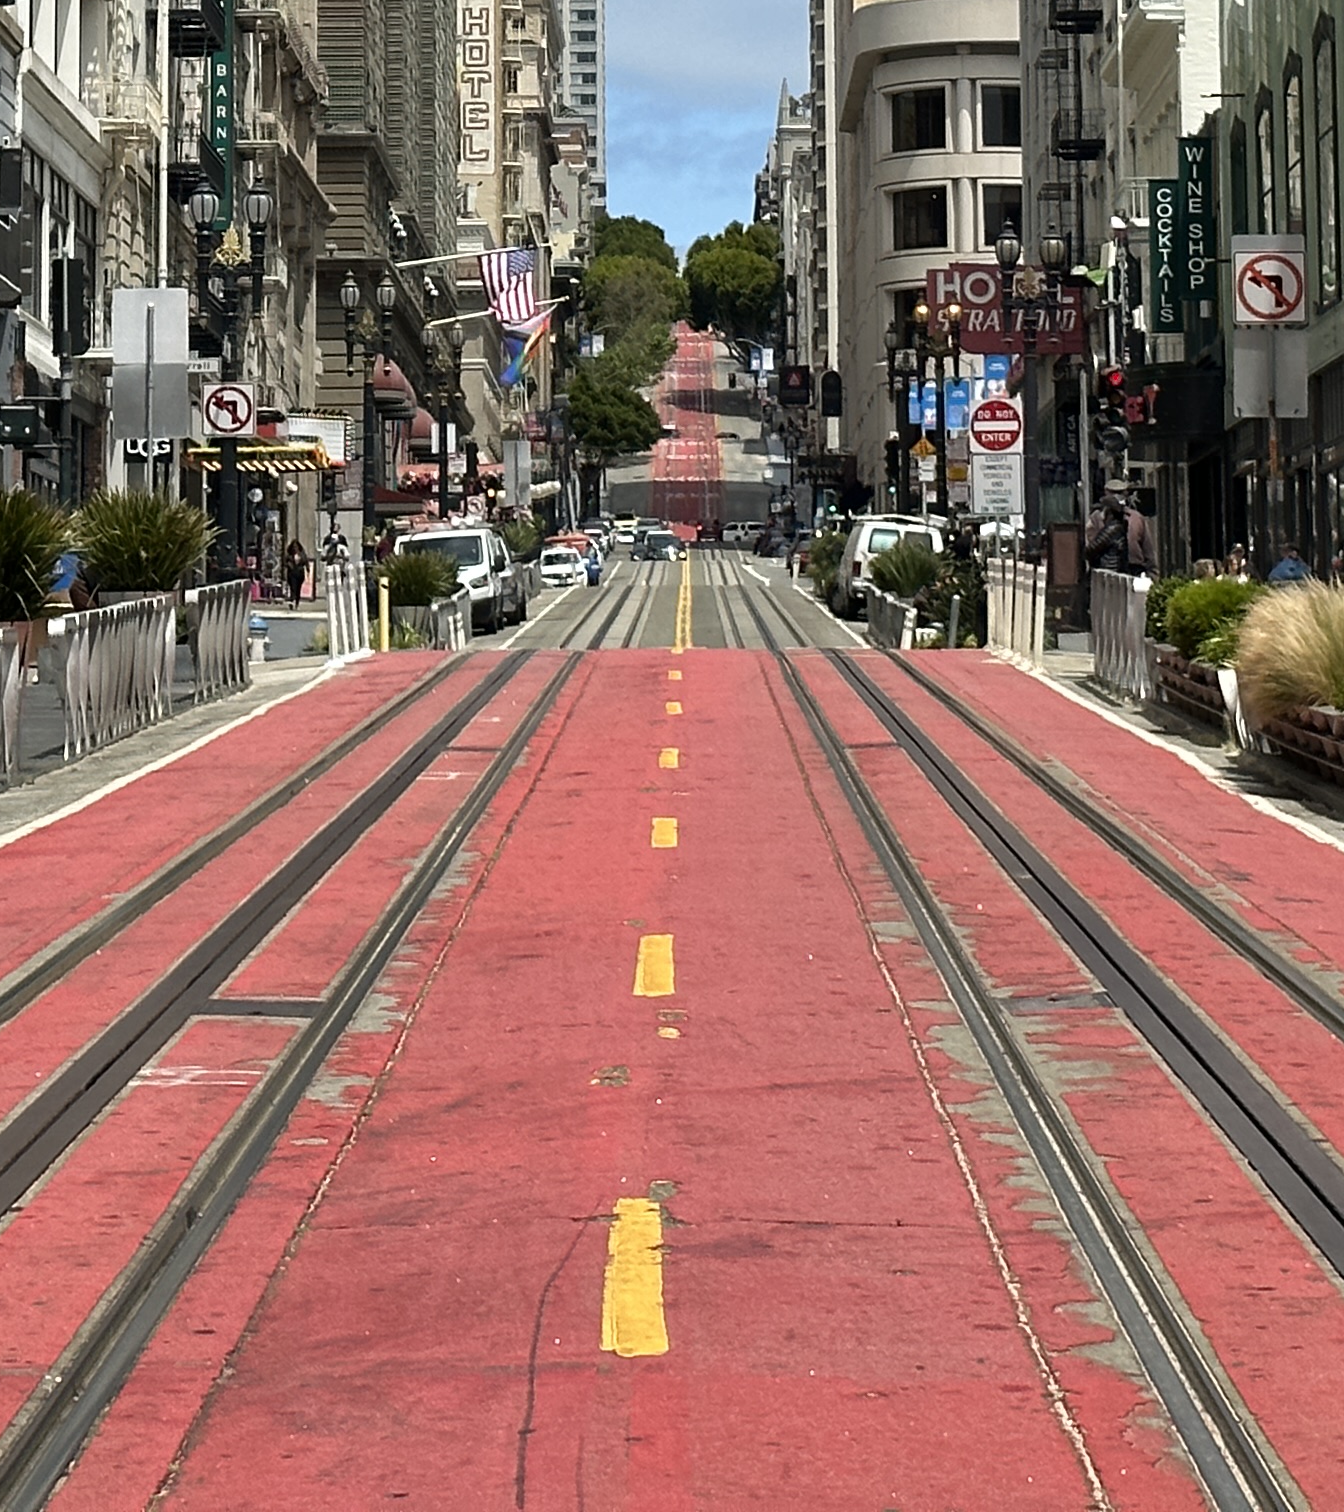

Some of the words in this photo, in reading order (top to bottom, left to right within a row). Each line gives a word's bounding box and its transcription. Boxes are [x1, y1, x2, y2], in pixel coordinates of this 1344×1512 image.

[461, 7, 494, 163] HOTEL
[1185, 146, 1205, 214] WINE
[1156, 188, 1175, 323] COCKTAILS
[1187, 223, 1206, 290] SHOP
[977, 410, 991, 419] DO
[995, 409, 1015, 419] NOT
[981, 433, 1011, 442] ENTER
